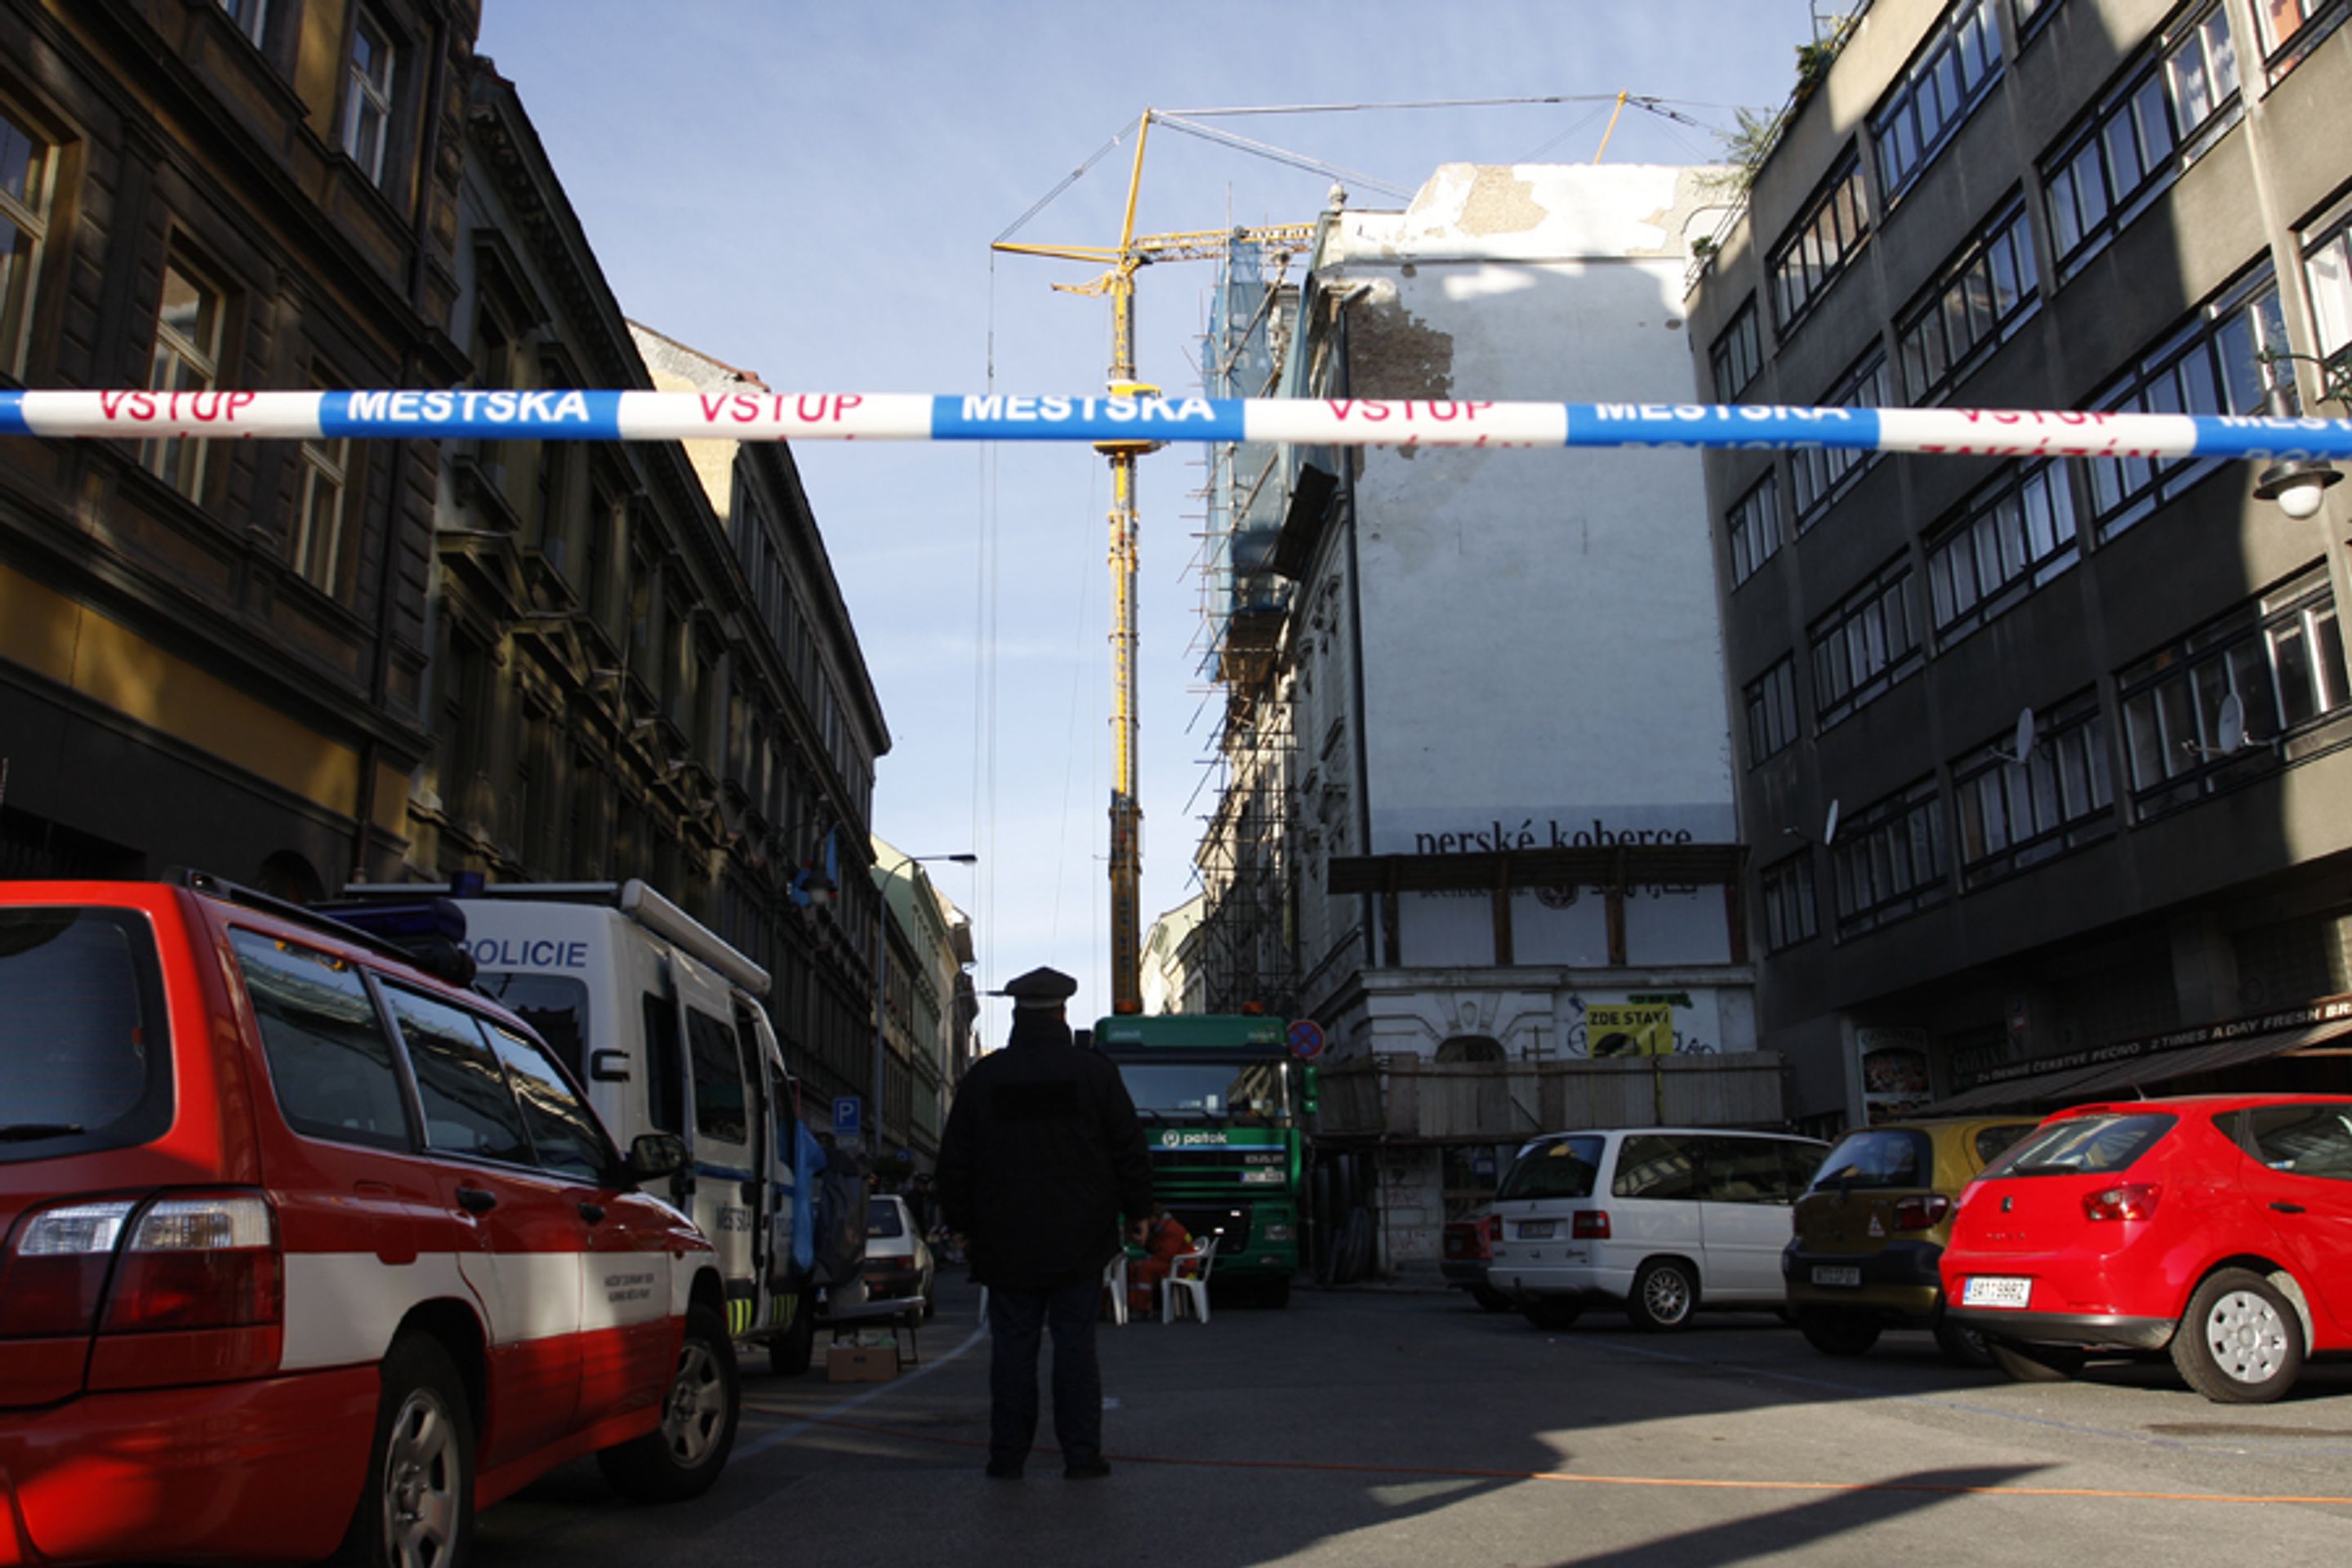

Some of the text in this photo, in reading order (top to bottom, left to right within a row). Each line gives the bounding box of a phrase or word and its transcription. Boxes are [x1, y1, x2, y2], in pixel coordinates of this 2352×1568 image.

[100, 391, 256, 421] VSTUP
[348, 391, 590, 422] MESTSKA
[700, 393, 863, 422] VSTUP
[1327, 399, 1494, 421] VSTUP
[1549, 819, 1692, 848] koberce
[461, 938, 588, 968] OLICIE
[1589, 1011, 1619, 1026] ZDE
[2161, 1029, 2207, 1047] TIMES
[2212, 1026, 2225, 1040] A
[2225, 1018, 2261, 1036] DAY
[2262, 1007, 2320, 1031] FRESH
[839, 1102, 854, 1125] P
